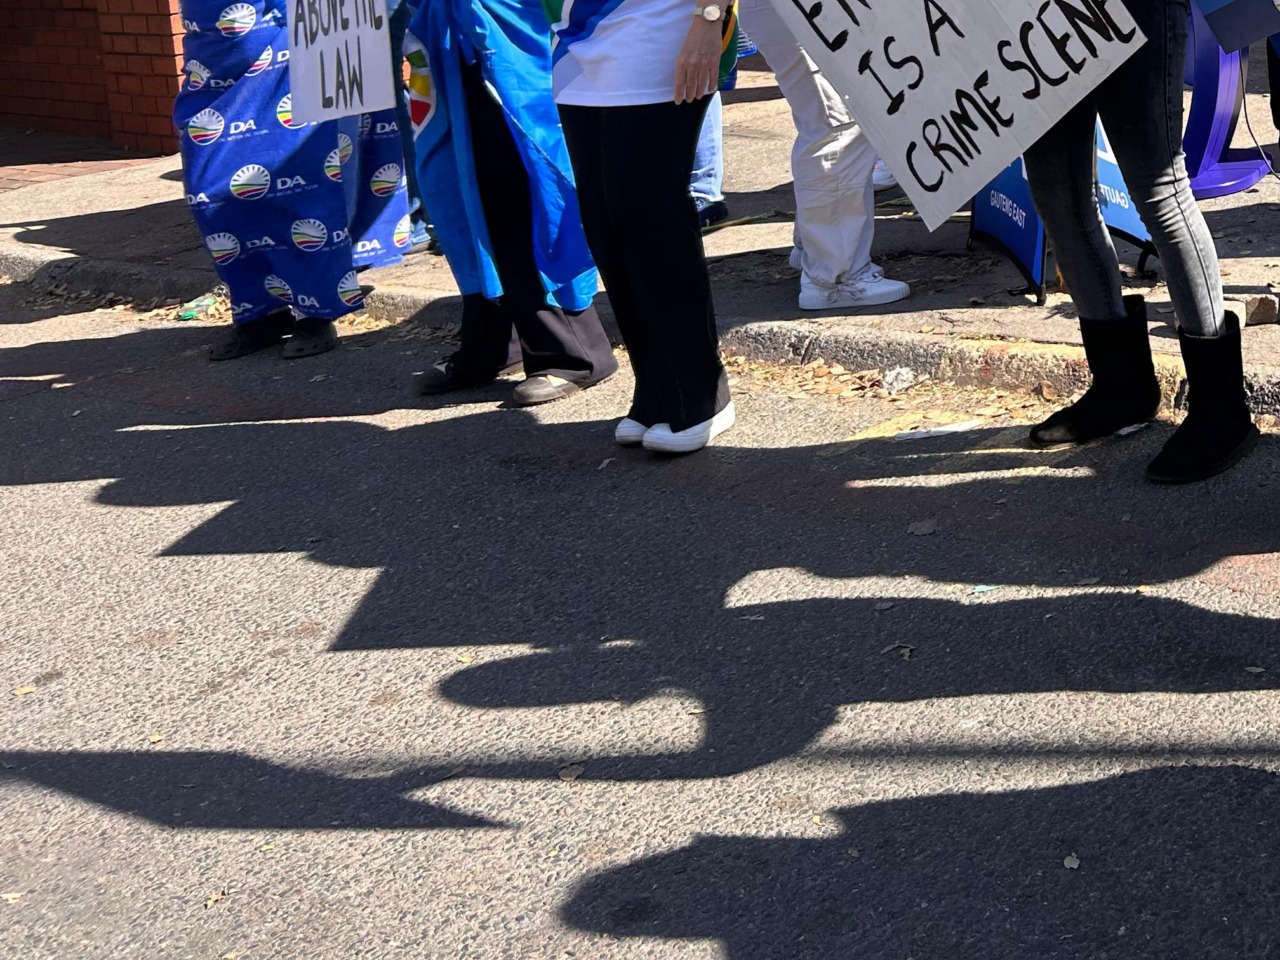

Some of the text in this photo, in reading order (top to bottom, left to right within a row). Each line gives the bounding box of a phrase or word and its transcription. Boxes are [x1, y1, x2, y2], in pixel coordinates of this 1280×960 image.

[319, 35, 364, 110] LAW
[858, 35, 924, 116] IS
[229, 119, 257, 135] DA
[376, 121, 398, 134] DA
[906, 70, 1014, 192] CRIME
[277, 175, 306, 190] DA
[187, 192, 210, 205] DA
[1012, 202, 1026, 229] EAST
[246, 235, 276, 248] DA
[357, 239, 382, 253] DA
[298, 295, 320, 308] DA
